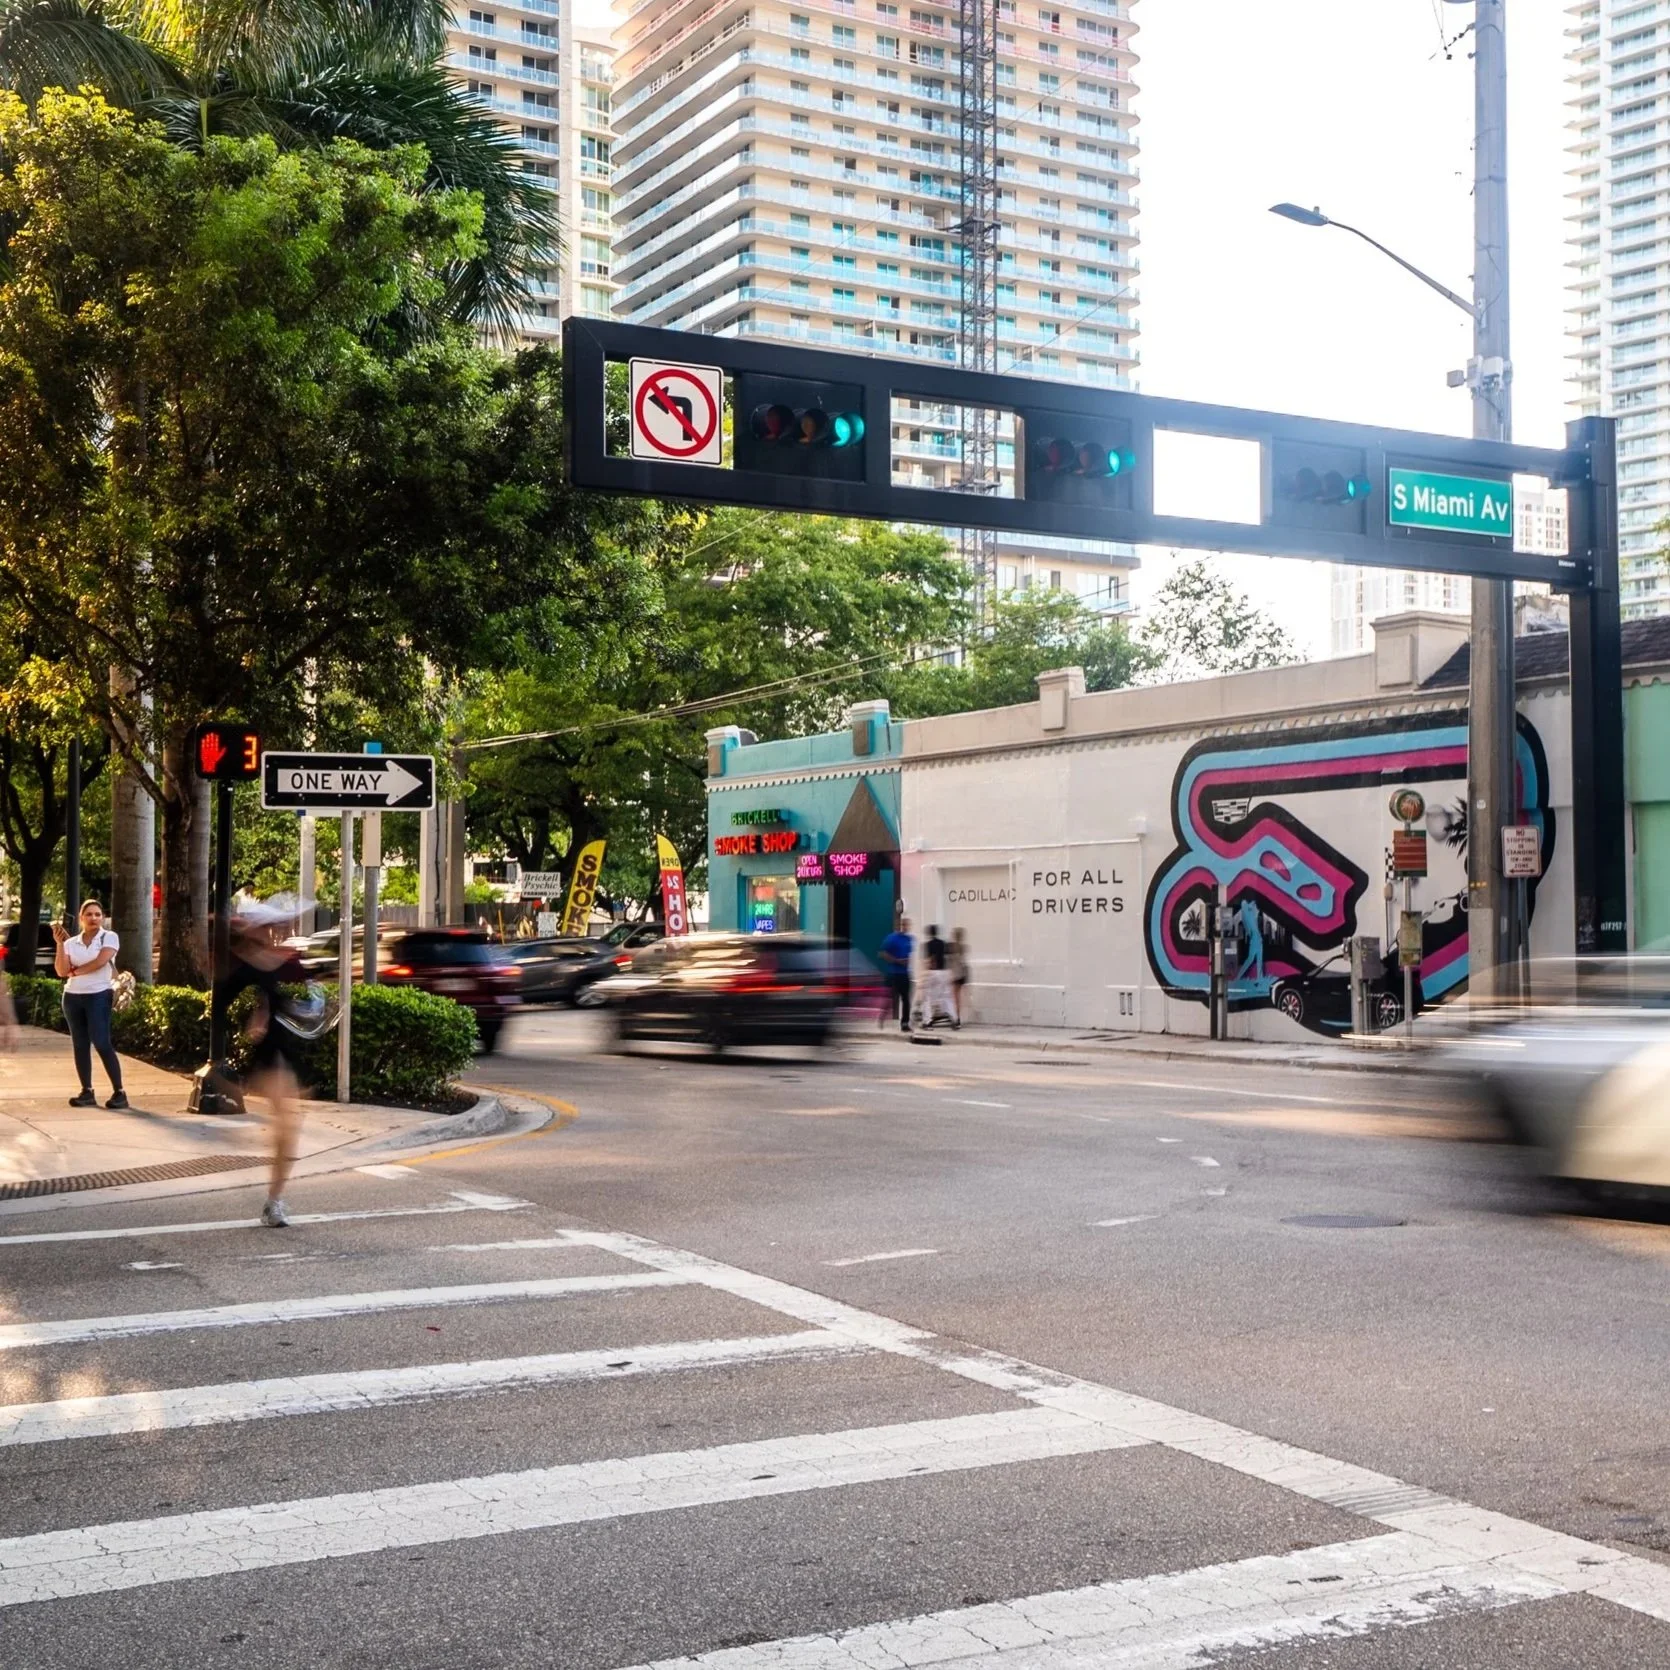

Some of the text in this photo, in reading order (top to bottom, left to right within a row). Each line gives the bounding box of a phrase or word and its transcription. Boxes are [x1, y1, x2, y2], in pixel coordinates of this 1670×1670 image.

[1393, 483, 1508, 522] S Miami Av
[244, 735, 258, 770] 3
[291, 772, 382, 791] ONE WAY
[731, 809, 779, 825] BRICKELL
[1515, 828, 1525, 836] NO
[714, 831, 798, 856] SMOKE SHOP
[801, 855, 817, 866] OPEN
[829, 853, 867, 865] SMOKE
[524, 873, 559, 882] Brickell
[834, 865, 864, 876] SHOP
[1032, 869, 1123, 886] FOR ALL
[524, 881, 558, 889] Psychic
[949, 888, 1016, 902] CADILLAC
[1032, 897, 1124, 914] DRIVERS
[755, 920, 774, 930] VAPES
